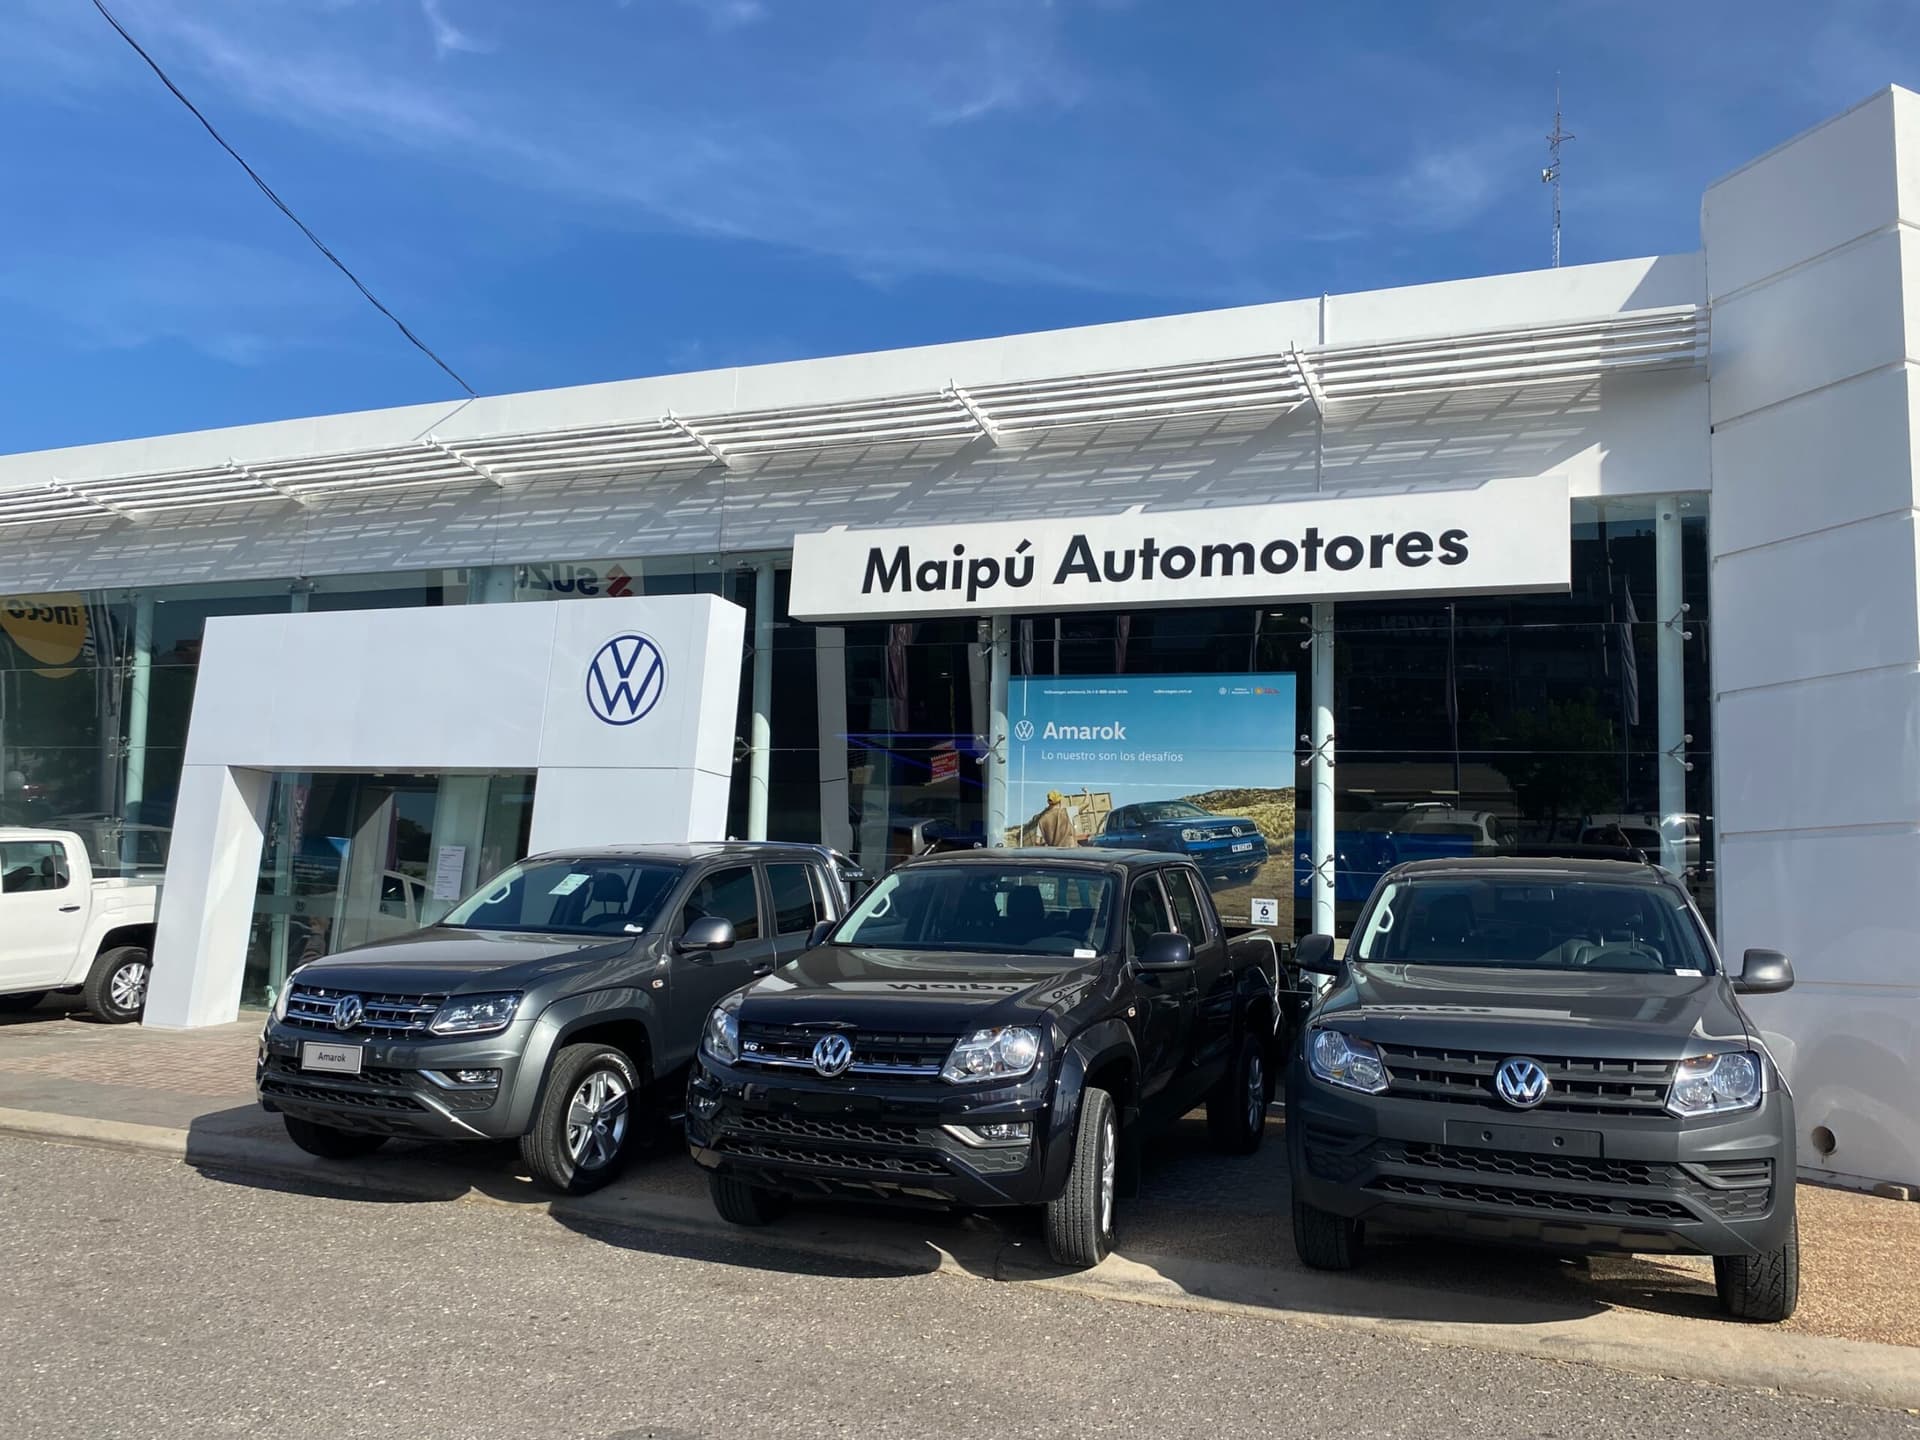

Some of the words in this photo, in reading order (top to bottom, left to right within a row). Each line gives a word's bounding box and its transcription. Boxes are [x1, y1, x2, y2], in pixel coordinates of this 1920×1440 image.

[862, 539, 1035, 602] Maipú
[1053, 527, 1470, 585] Automotores
[1042, 721, 1127, 741] Amarok
[1041, 751, 1053, 761] Lo
[1056, 751, 1096, 761] nuestro
[1098, 752, 1118, 762] son
[1120, 751, 1136, 762] los
[1138, 751, 1184, 762] desafíos
[1260, 905, 1269, 916] 6
[318, 1051, 347, 1063] Amarok
